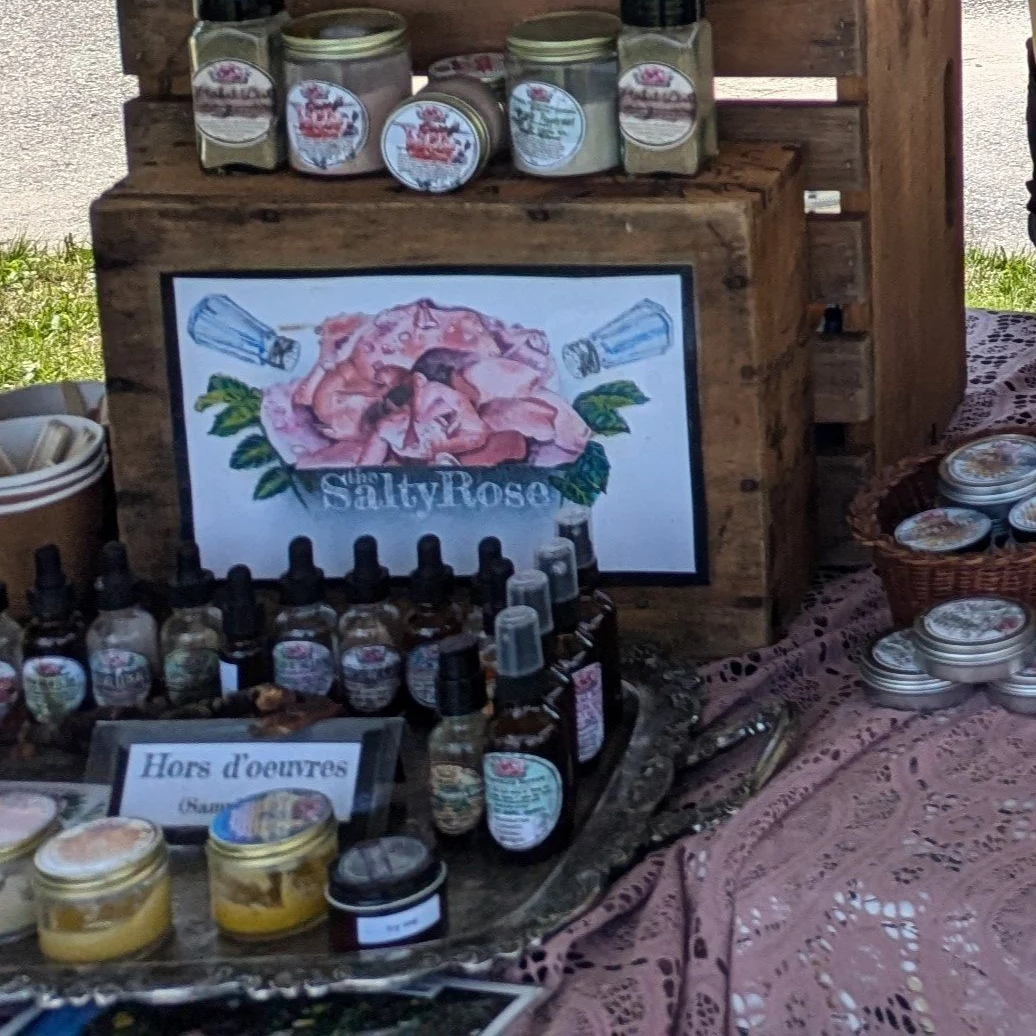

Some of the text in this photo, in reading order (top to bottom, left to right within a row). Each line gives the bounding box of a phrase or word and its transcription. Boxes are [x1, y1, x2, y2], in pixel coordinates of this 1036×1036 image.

[346, 468, 379, 485] the
[140, 752, 348, 780] Hors d'oeuvres
[178, 796, 234, 815] (Sam
